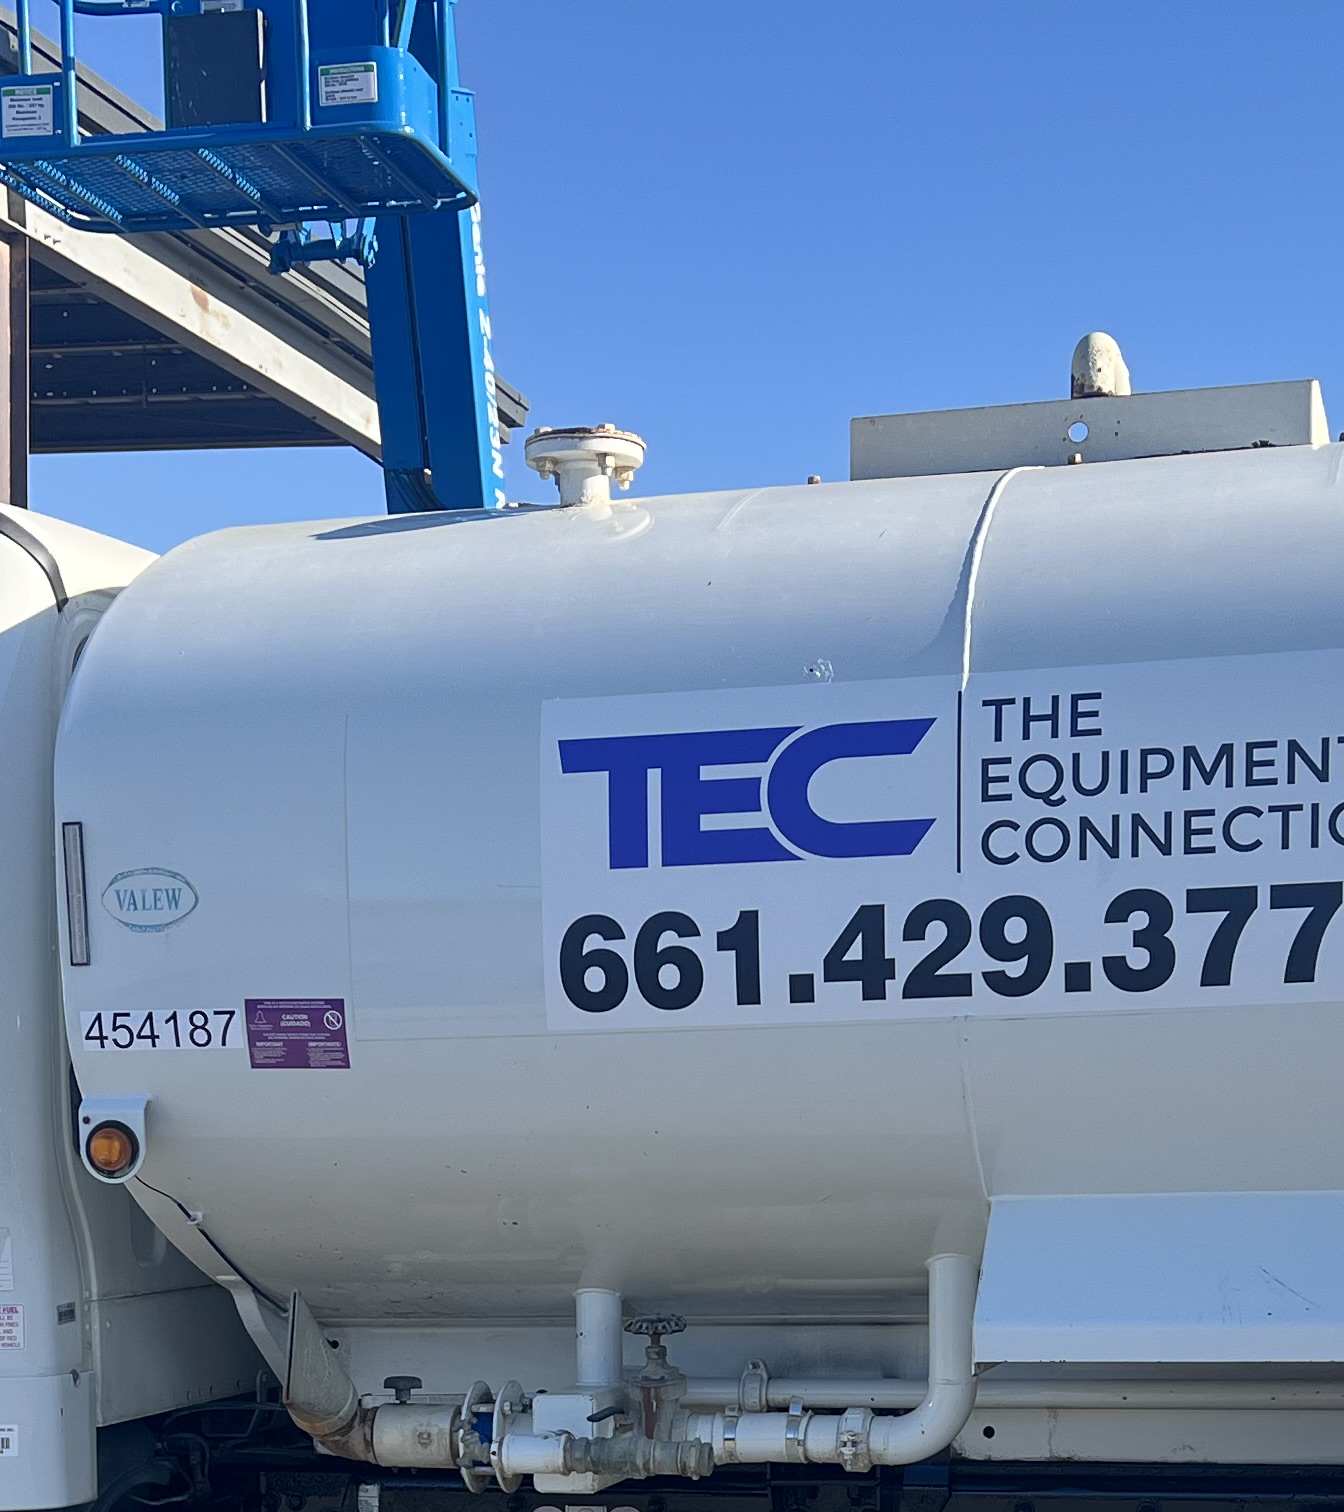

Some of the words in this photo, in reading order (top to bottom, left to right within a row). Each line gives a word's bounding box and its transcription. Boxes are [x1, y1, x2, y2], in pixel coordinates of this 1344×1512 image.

[981, 692, 1104, 743] THE
[557, 717, 939, 870] TEC
[114, 887, 183, 912] VALEW
[84, 1010, 237, 1049] 454187
